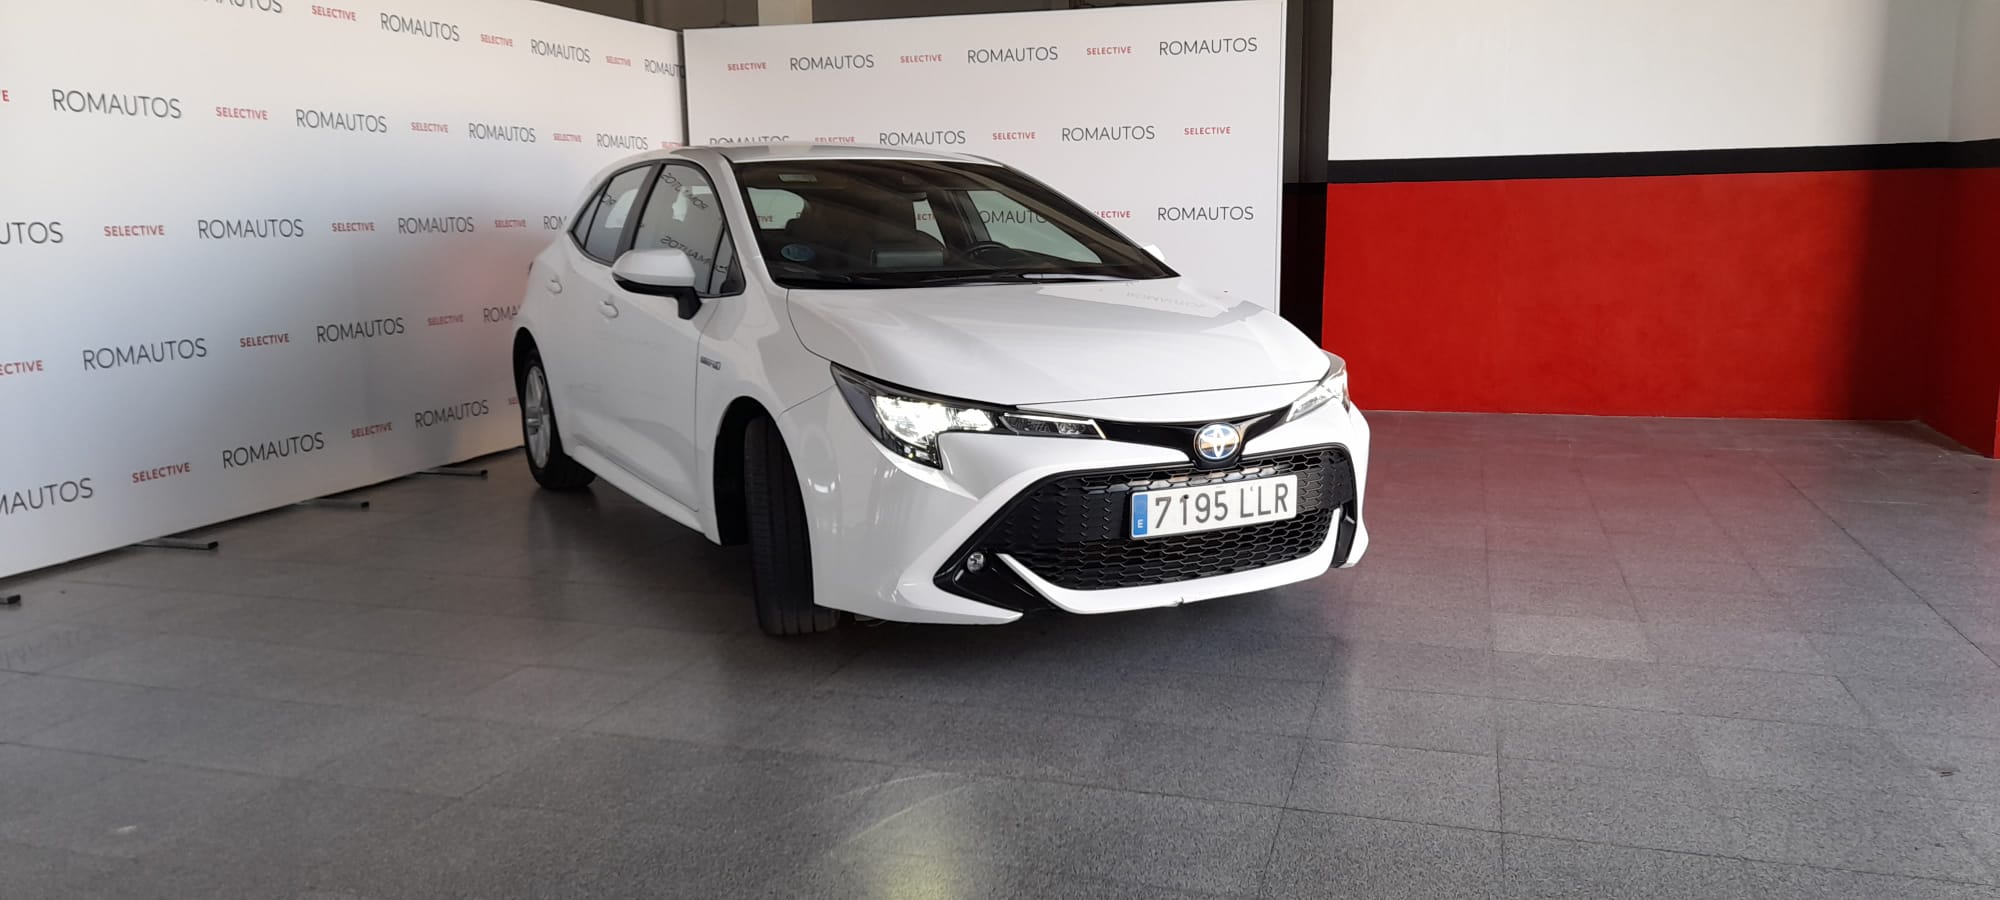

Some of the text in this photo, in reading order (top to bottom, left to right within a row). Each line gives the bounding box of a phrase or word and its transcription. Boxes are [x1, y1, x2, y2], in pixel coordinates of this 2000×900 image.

[311, 4, 357, 22] SELECTIVE
[380, 12, 460, 42] ROMAUTOS
[480, 33, 513, 48] SELECTIVE
[530, 38, 591, 64] ROMAUTOS
[605, 55, 632, 67] SELECTIVE
[727, 36, 1258, 72] SELECTIVE ROMAUTOS SELECTIVE ROMAUTOS SELECTIVE ROMAUTOS
[51, 88, 182, 119] ROMAUTOS
[215, 106, 268, 121] SELECTIVE
[295, 108, 388, 134] ROMAUTOS
[410, 121, 449, 134] SELECTIVE
[468, 122, 537, 143] ROMAUTOS
[552, 132, 582, 143] SELECTIVE
[596, 133, 649, 151] ROMAUTOS
[879, 130, 966, 146] ROMAUTOS
[992, 131, 1036, 141] SELECTIVE
[1061, 125, 1156, 142] ROMAUTOS
[1183, 126, 1231, 136] SELECTIVE
[103, 224, 165, 238] SELECTIVE
[197, 218, 304, 240] ROMAUTOS
[331, 221, 375, 233] SELECTIVE
[397, 216, 475, 235] ROMAUTOS
[494, 219, 527, 229] SELECTIVE
[1157, 206, 1254, 221] ROMAUTOS
[82, 337, 208, 371] ROMAUTOS
[239, 333, 290, 348] SELECTIVE
[316, 316, 405, 344] ROMAUTOS
[427, 313, 464, 327] SELECTIVE
[132, 462, 191, 483] SELECTIVE
[222, 431, 325, 469] ROMAUTOS
[350, 421, 393, 439] SELECTIVE
[414, 399, 489, 429] ROMAUTOS
[1137, 518, 1144, 529] E
[1155, 482, 1289, 529] 7195 LLR
